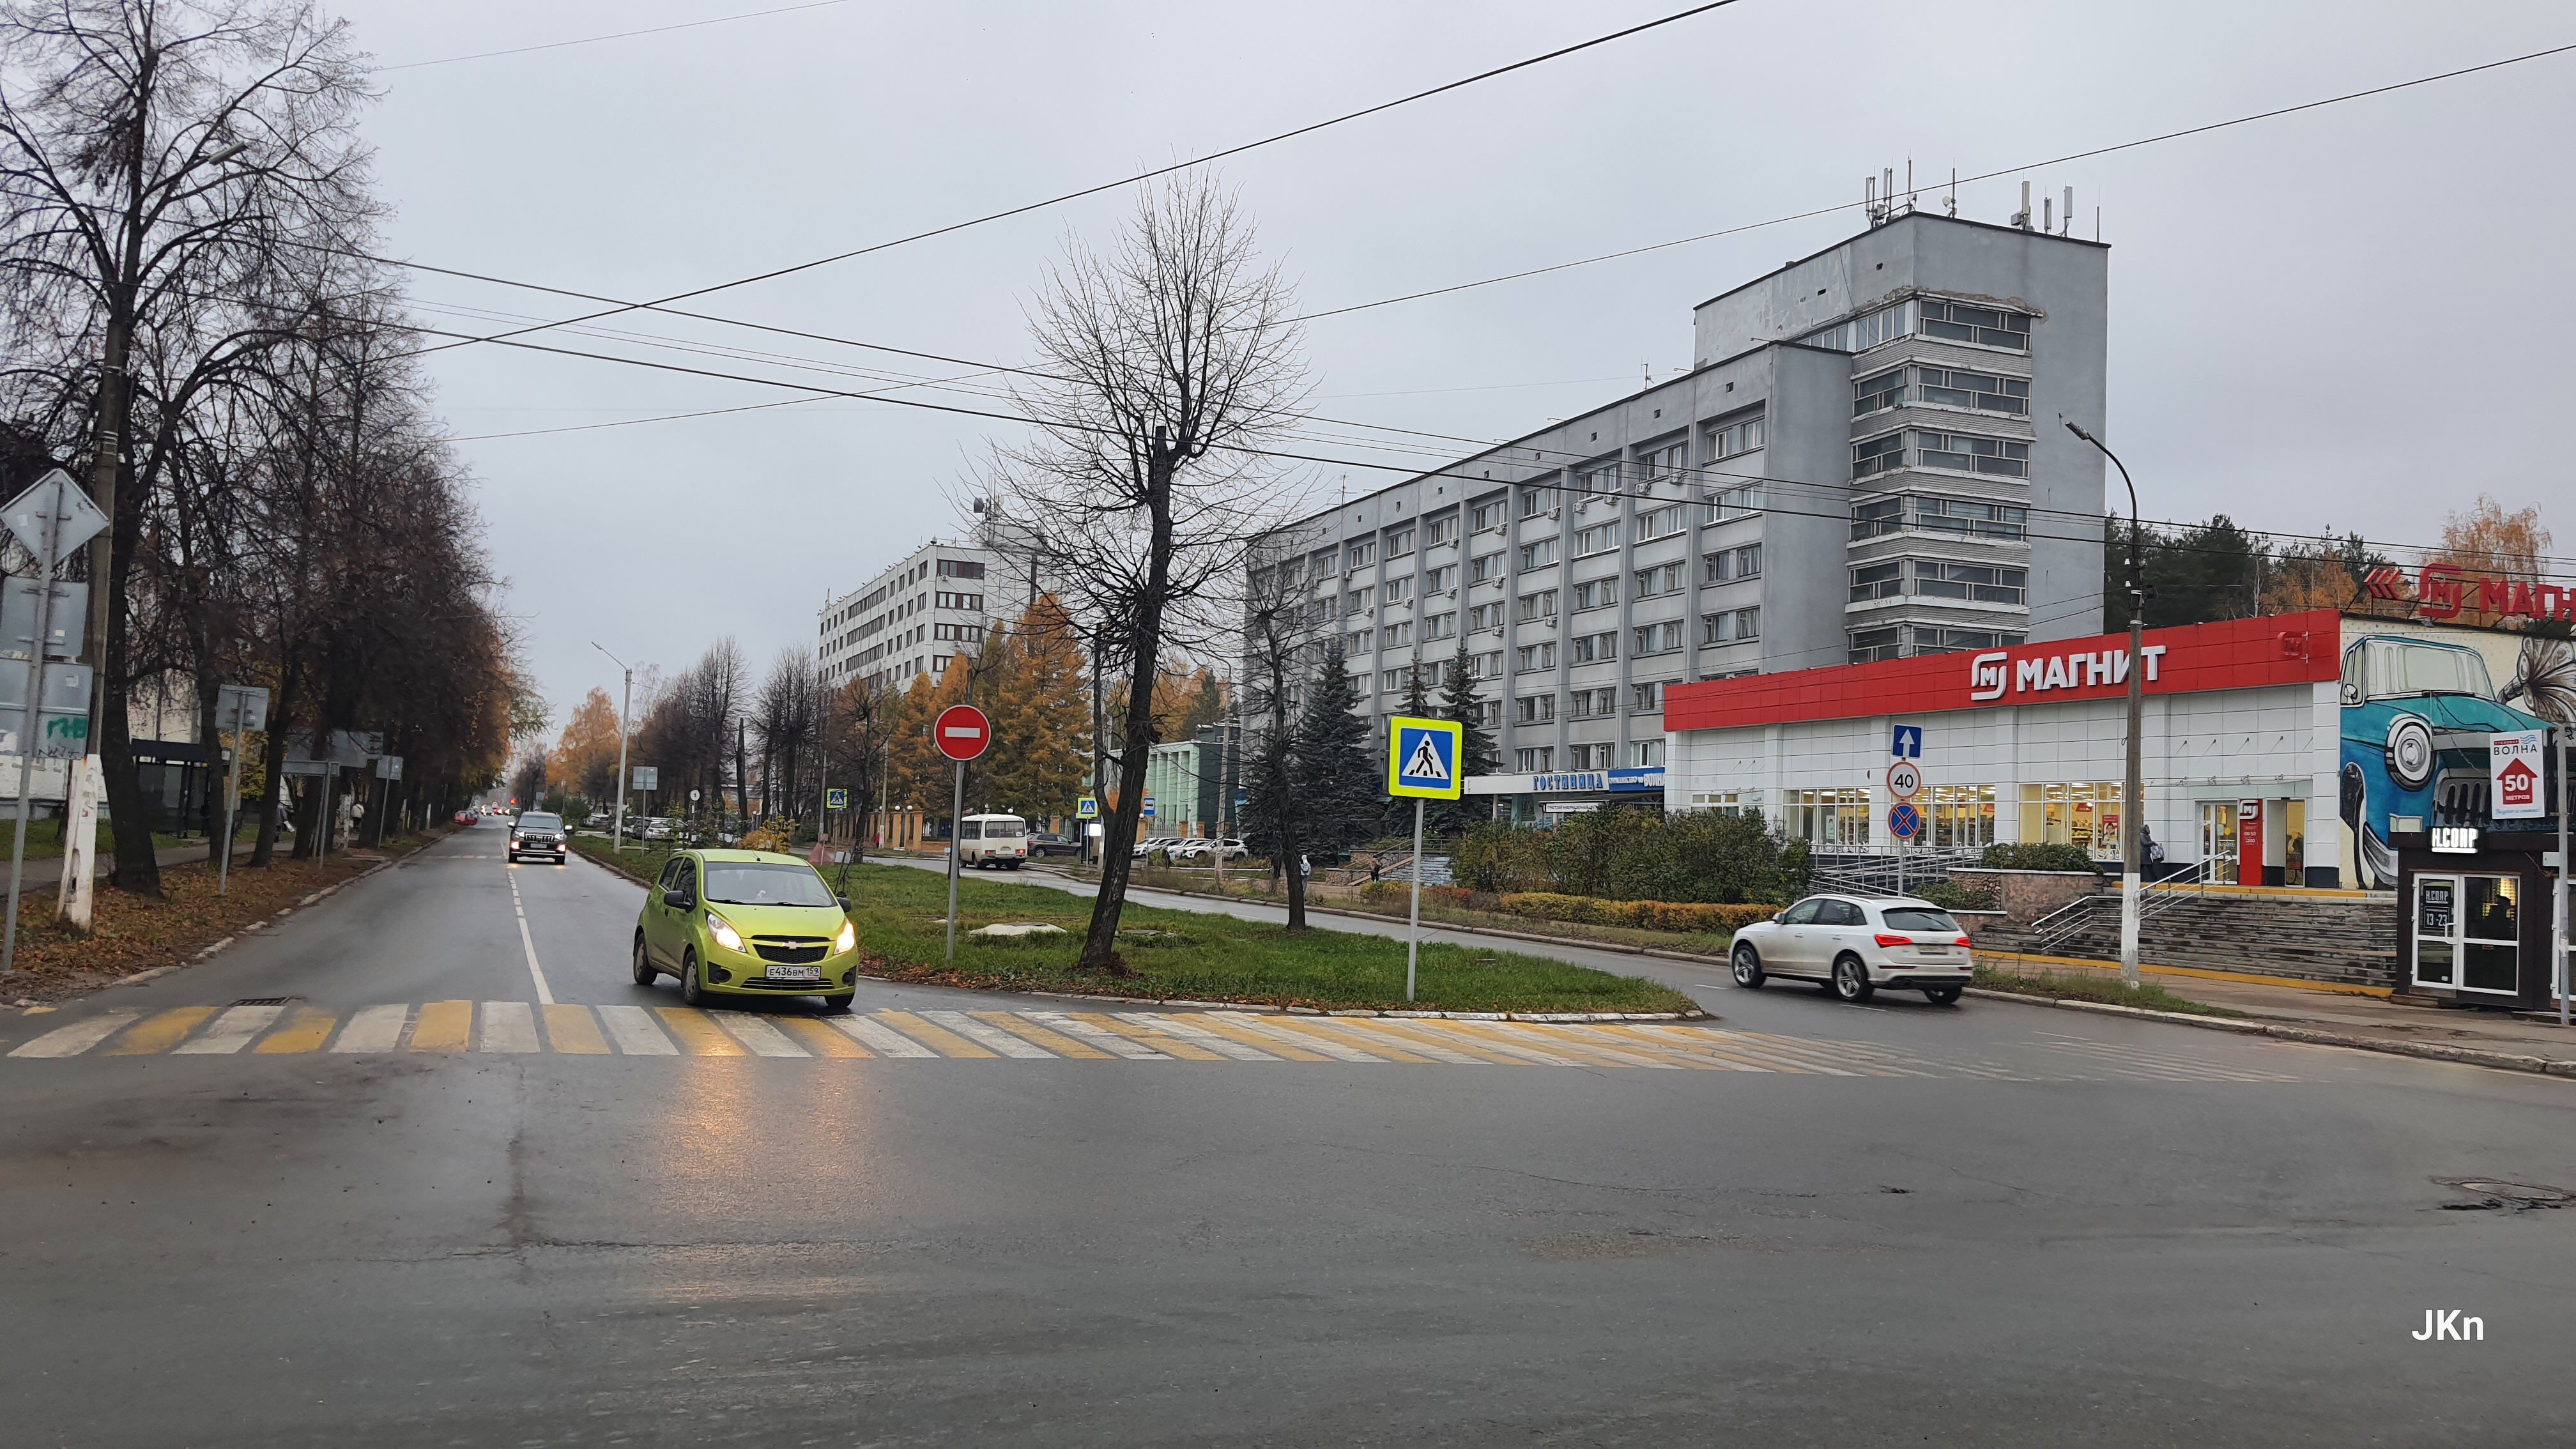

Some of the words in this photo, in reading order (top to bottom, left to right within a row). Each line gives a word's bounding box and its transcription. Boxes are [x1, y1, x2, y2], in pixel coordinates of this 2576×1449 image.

[2016, 645, 2166, 692] МАГНИТ
[2494, 744, 2538, 756] ВОЛНА
[1533, 773, 1603, 791] ГОСТИНИЦА
[1894, 774, 1913, 788] 40
[2504, 774, 2529, 792] 50
[769, 967, 804, 976] Е436ВМ
